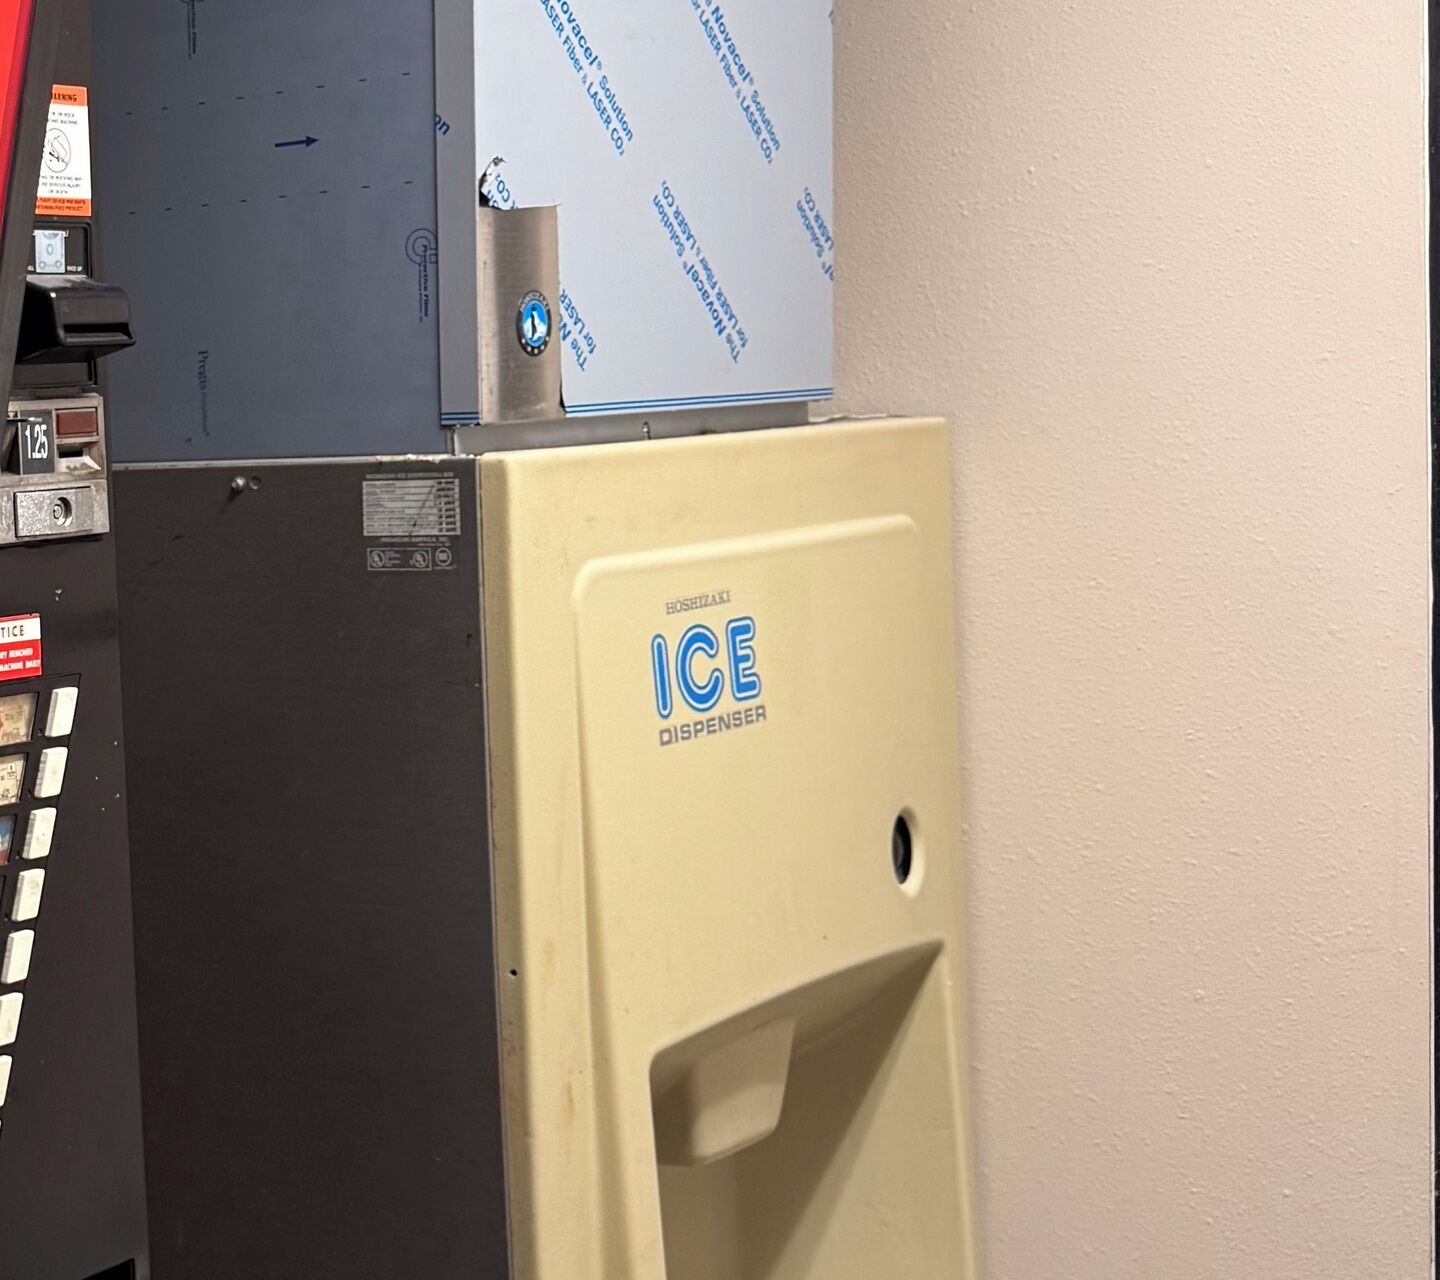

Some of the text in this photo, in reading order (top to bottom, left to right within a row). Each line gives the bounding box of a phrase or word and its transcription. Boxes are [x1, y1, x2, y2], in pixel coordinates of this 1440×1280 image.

[563, 35, 583, 74] Fiber
[587, 81, 612, 130] LASER
[699, 9, 721, 56] LASER
[740, 96, 761, 141] LASER
[599, 75, 633, 141] Solution
[750, 89, 780, 151] Solution
[653, 194, 685, 257] Solution
[673, 205, 697, 250] LASER
[560, 288, 585, 335] LASER
[716, 287, 738, 330] LASER
[571, 339, 587, 372] The
[583, 332, 596, 354] for
[725, 333, 740, 365] The
[736, 327, 748, 348] for
[25, 424, 49, 459] 1.25
[666, 590, 731, 615] HOSHIZAKI
[651, 616, 761, 719] ICE
[659, 705, 767, 747] DISPENSER
